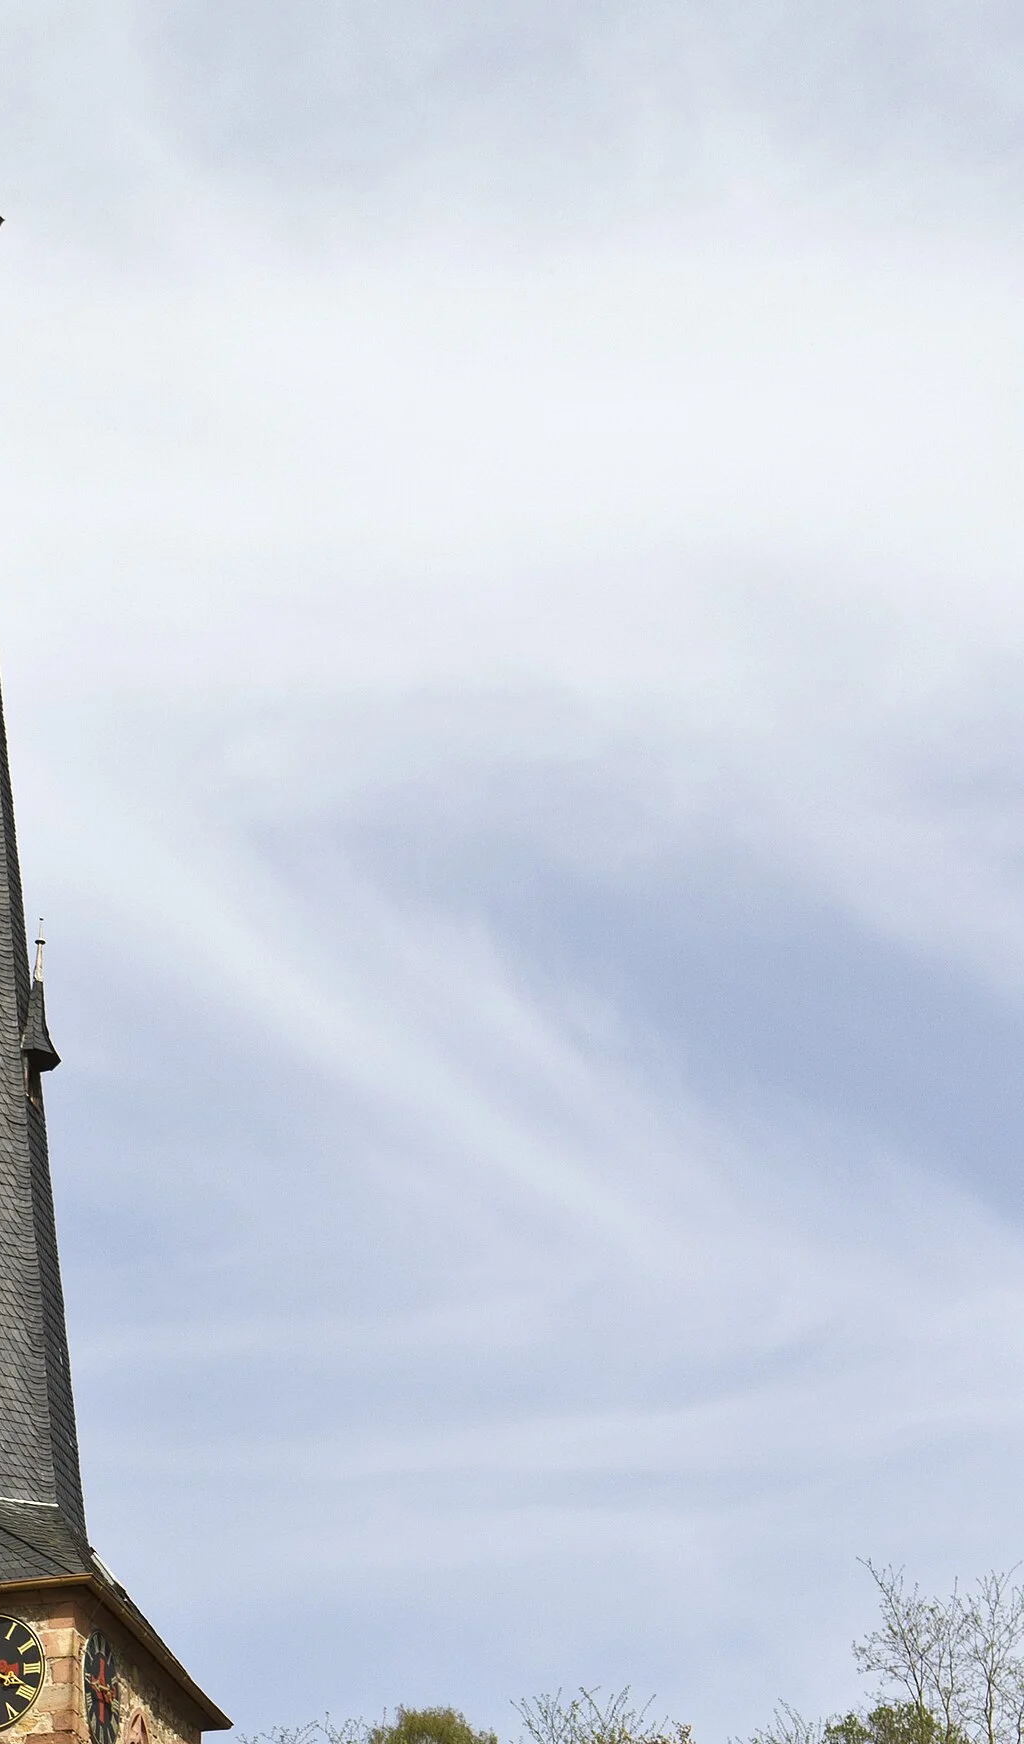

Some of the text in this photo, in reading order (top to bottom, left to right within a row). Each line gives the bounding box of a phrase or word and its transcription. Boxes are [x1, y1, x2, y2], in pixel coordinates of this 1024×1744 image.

[4, 1622, 17, 1640] I
[17, 1637, 36, 1655] II
[23, 1661, 41, 1676] III
[15, 1684, 37, 1702] IIII
[5, 1701, 19, 1720] V
